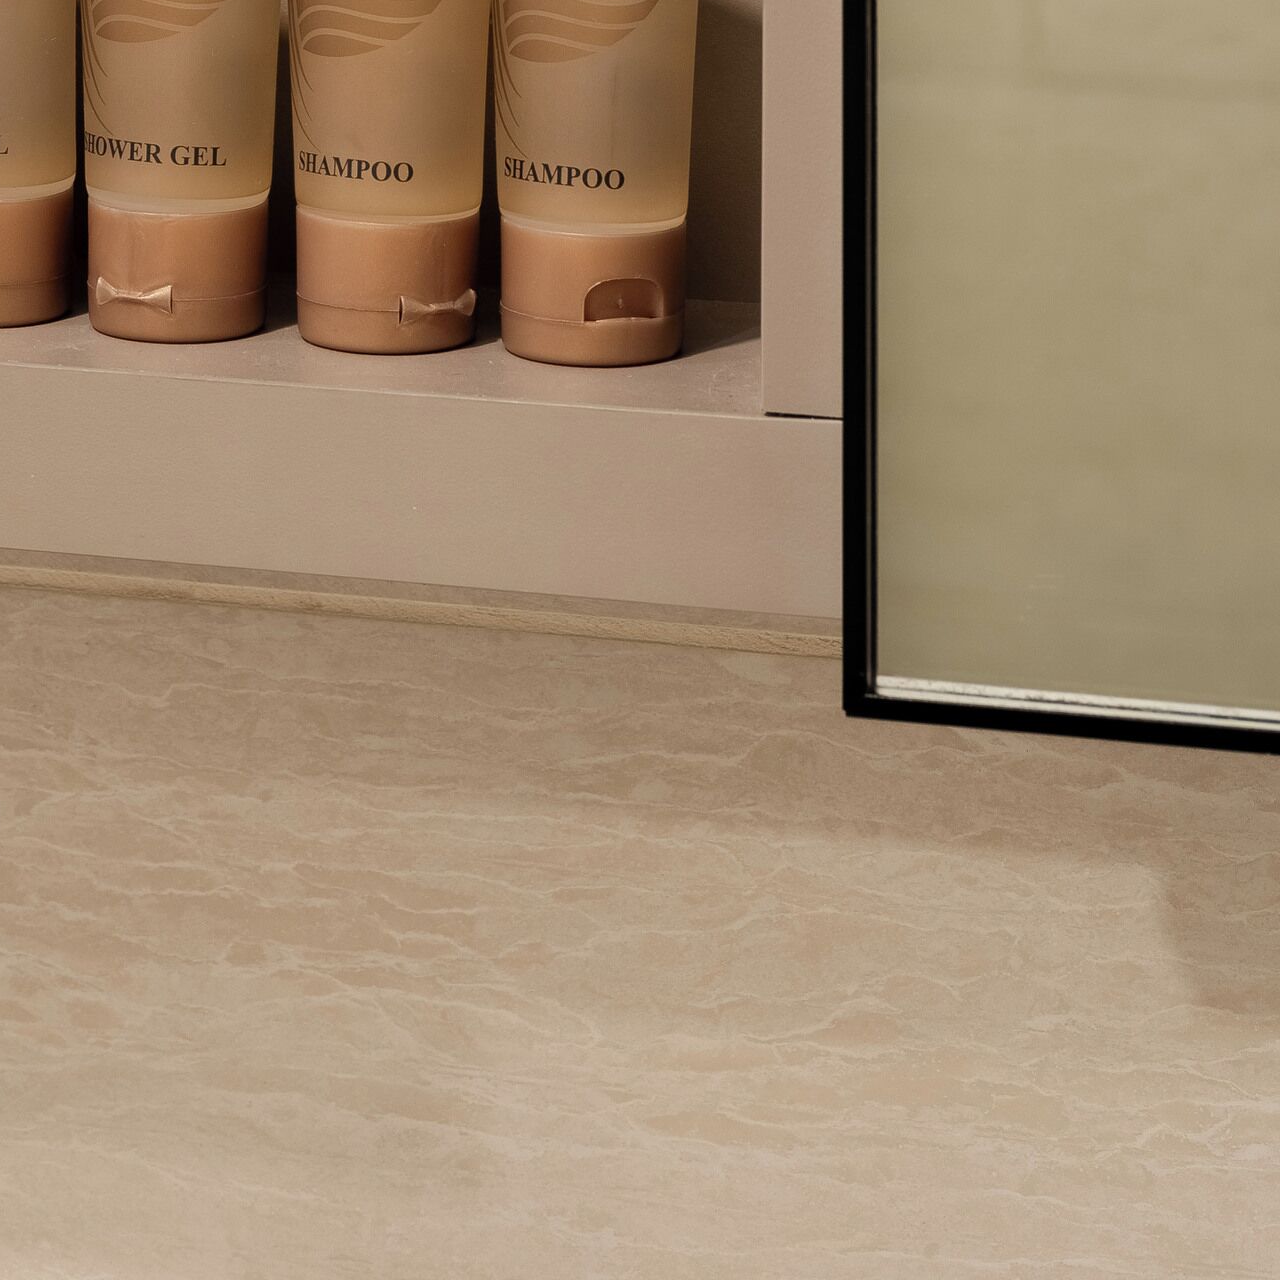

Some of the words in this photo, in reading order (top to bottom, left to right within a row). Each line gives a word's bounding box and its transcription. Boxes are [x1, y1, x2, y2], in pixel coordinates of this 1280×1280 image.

[170, 145, 228, 167] GEL
[298, 150, 415, 183] SHAMPOO
[504, 155, 626, 190] SHAMPOO
